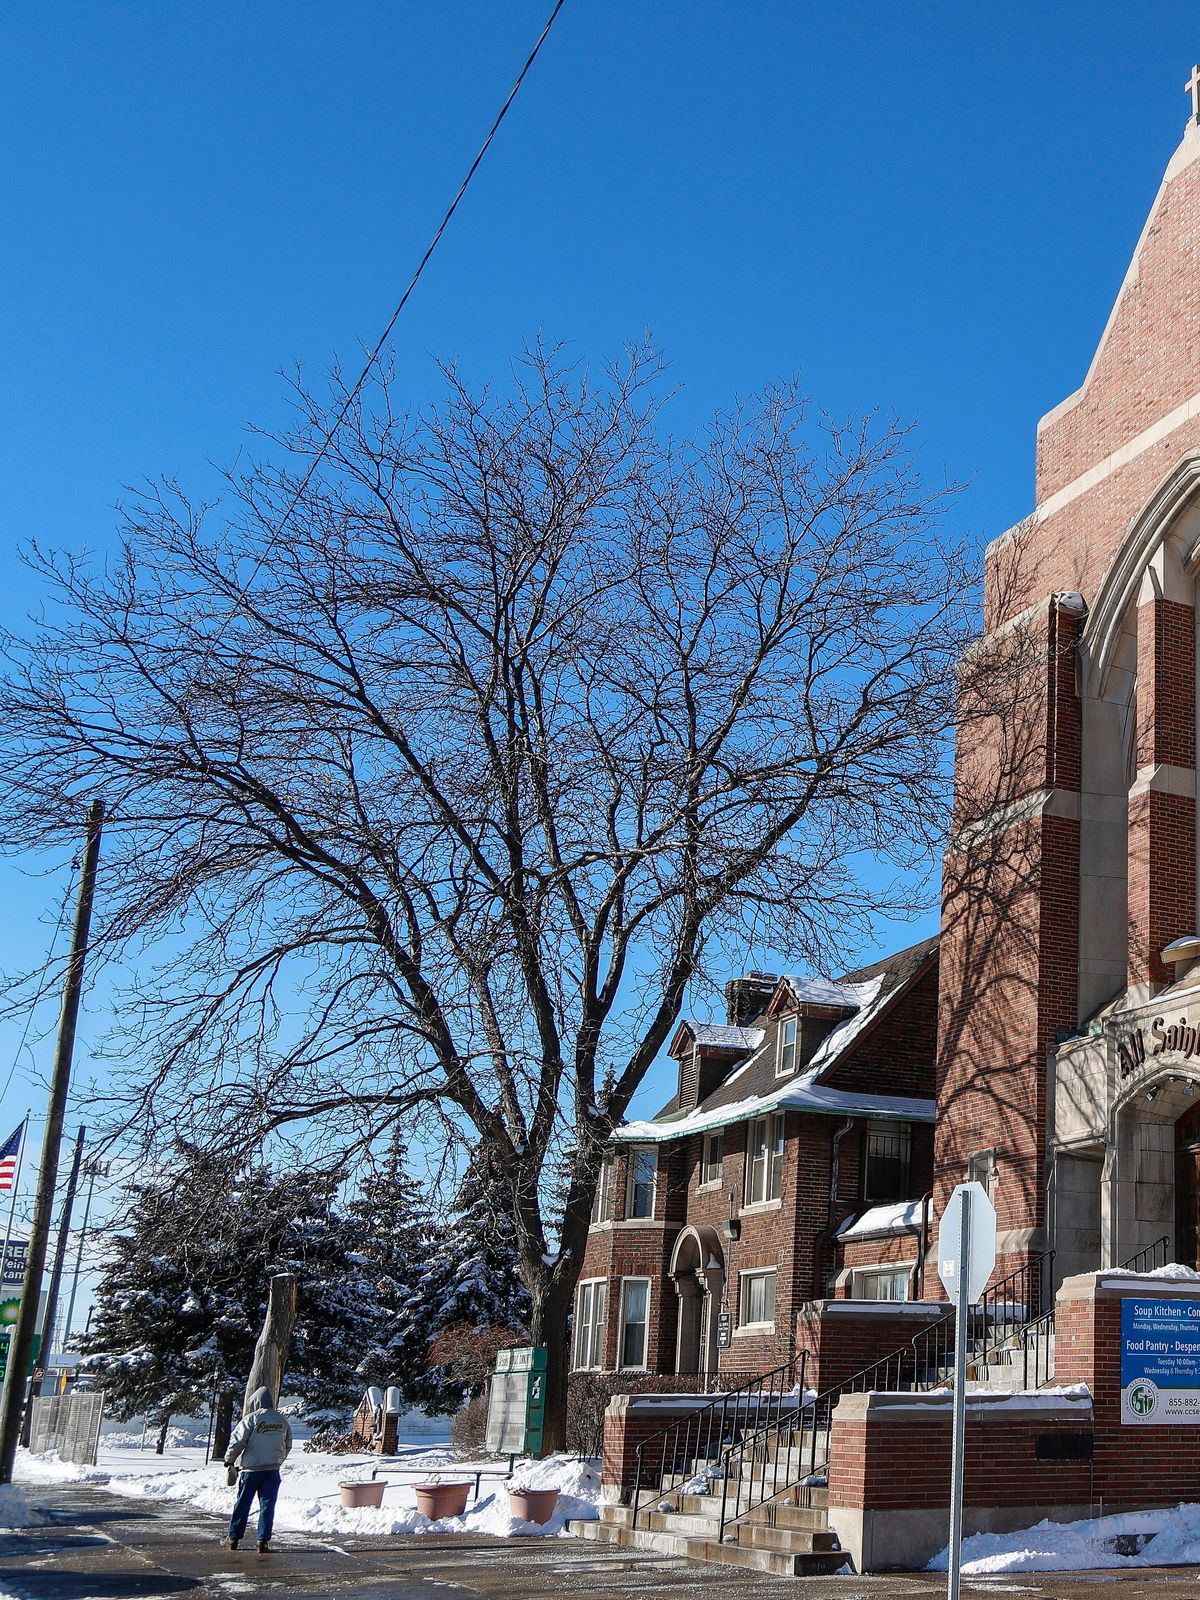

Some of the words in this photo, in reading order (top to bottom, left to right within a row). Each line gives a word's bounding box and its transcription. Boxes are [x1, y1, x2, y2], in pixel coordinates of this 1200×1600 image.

[1118, 1028, 1145, 1079] All
[1134, 1306, 1152, 1318] Soup
[1155, 1306, 1181, 1316] Kitchen
[1133, 1323, 1152, 1331] Monday,
[1153, 1324, 1179, 1332] Wednesday,
[1127, 1340, 1144, 1350] Food
[1146, 1341, 1169, 1353] Pantry
[1158, 1358, 1175, 1366] Tuesday
[1144, 1367, 1170, 1376] Wednesday
